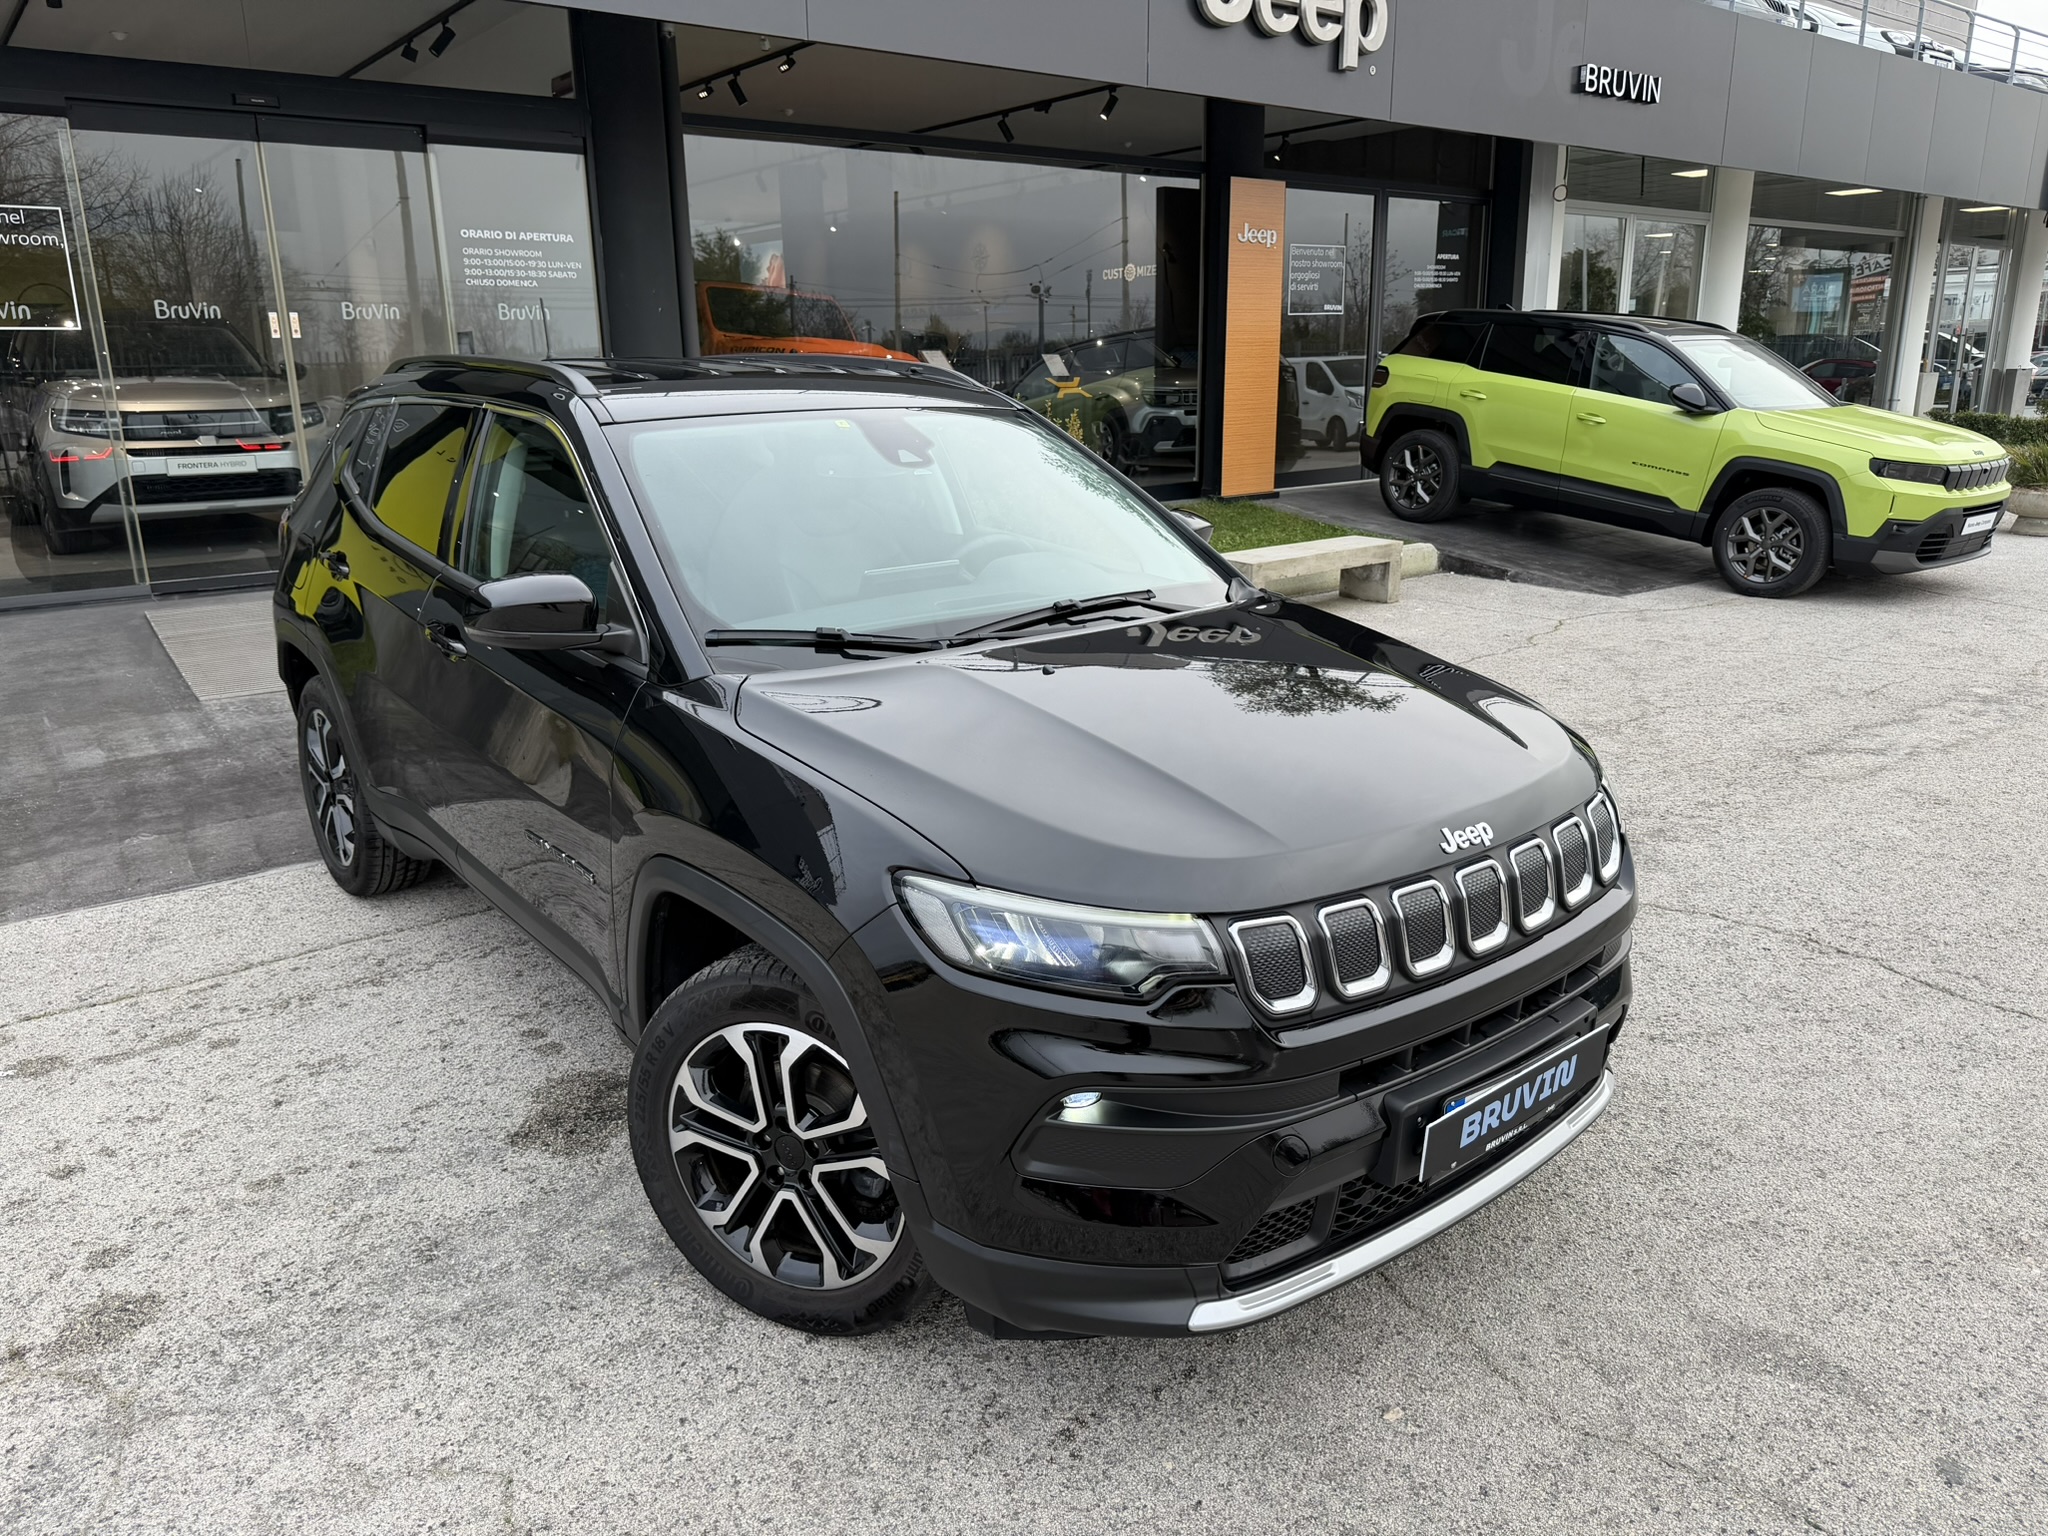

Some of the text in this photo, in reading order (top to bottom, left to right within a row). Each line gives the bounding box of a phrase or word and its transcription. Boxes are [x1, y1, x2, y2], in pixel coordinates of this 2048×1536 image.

[1198, 0, 1388, 71] eep
[1583, 63, 1662, 104] BRUVIN
[460, 229, 575, 243] ORARIO DI APERTURA
[1237, 222, 1278, 249] Jeep
[462, 247, 543, 258] ORARIO SHOWROOM
[547, 261, 582, 270] LUN-VEN
[547, 270, 578, 279] SABATO
[465, 277, 495, 287] CHIUSO
[153, 299, 222, 320] BruVin
[340, 301, 401, 320] BruVin
[497, 302, 551, 321] BruVin
[177, 460, 248, 470] FRONTERA HYBRID
[1439, 821, 1494, 855] Jeep
[1459, 1053, 1578, 1149] BRUVIN
[1485, 1130, 1514, 1152] BRUVIN
